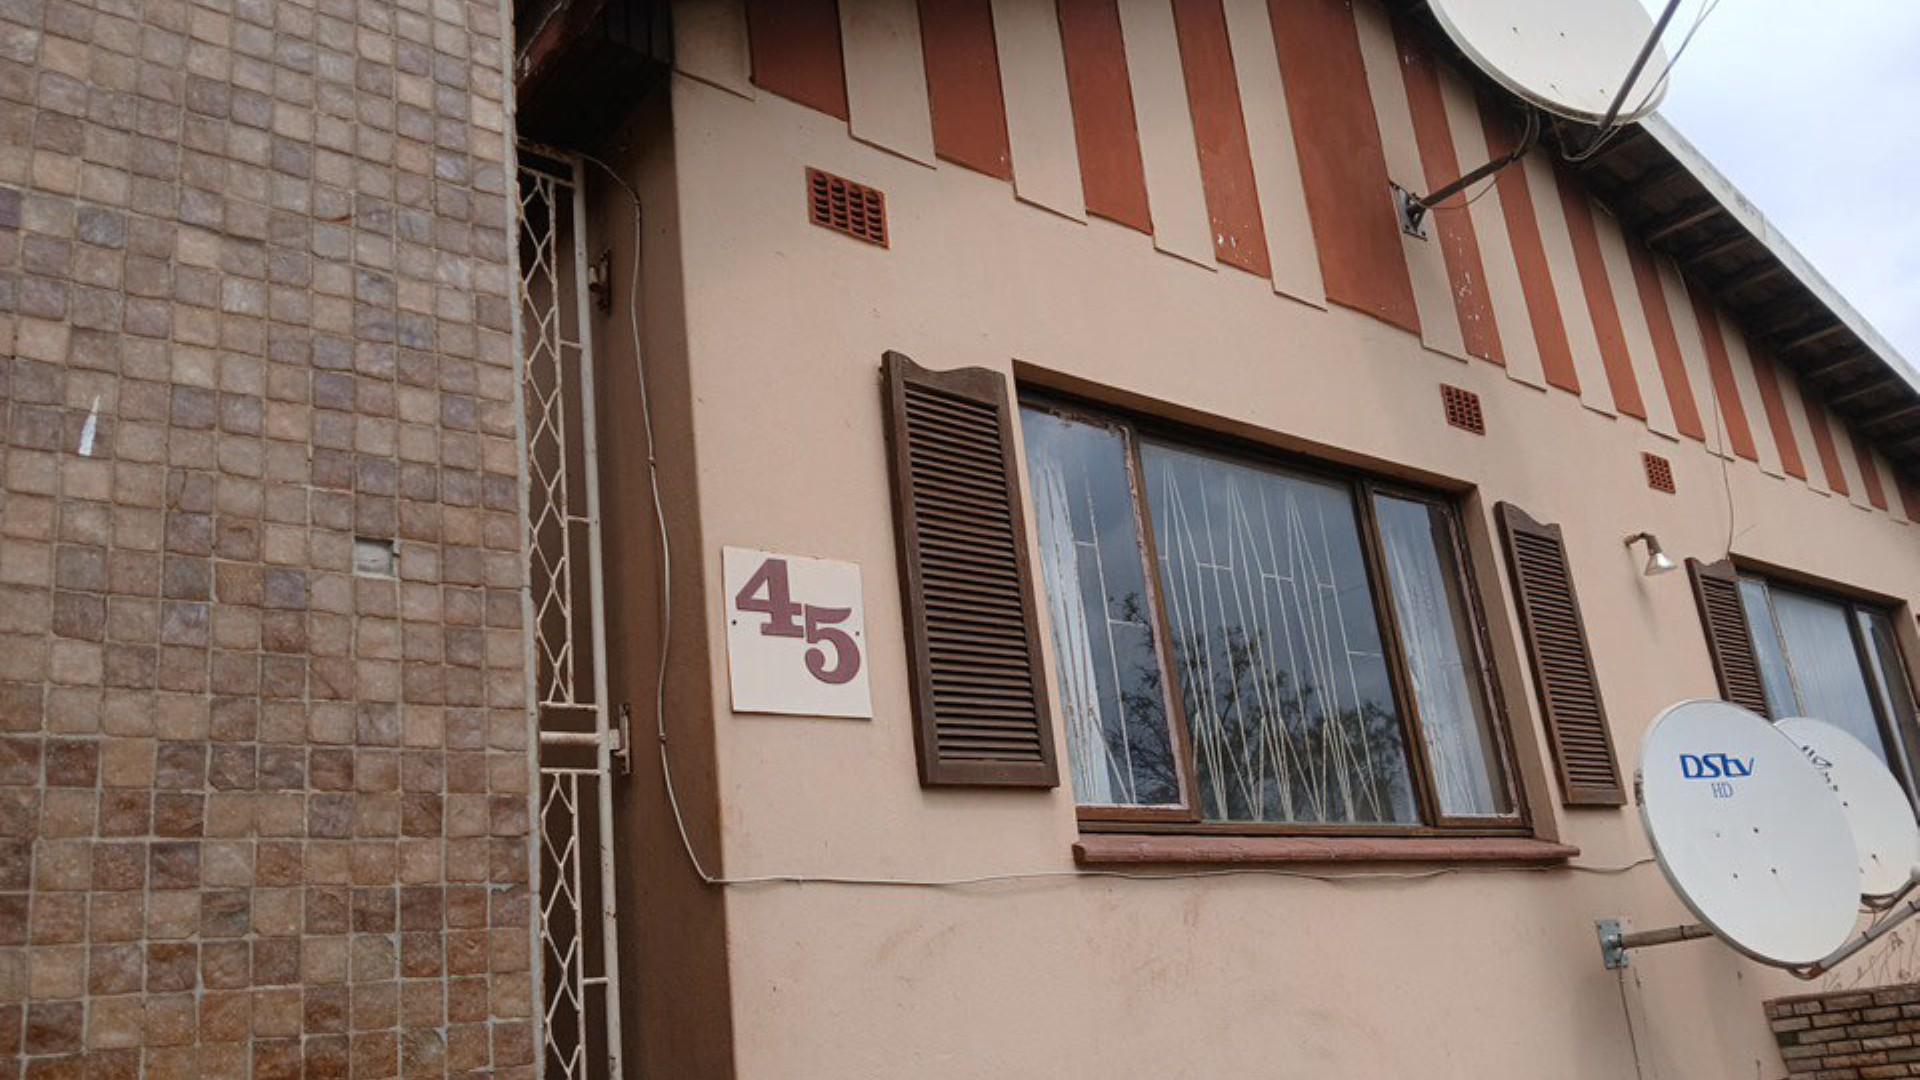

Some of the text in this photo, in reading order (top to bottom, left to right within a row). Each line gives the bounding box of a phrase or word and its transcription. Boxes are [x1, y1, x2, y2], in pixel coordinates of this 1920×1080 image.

[735, 558, 861, 685] 45
[1680, 753, 1754, 778] DStv
[1711, 782, 1734, 798] HD
